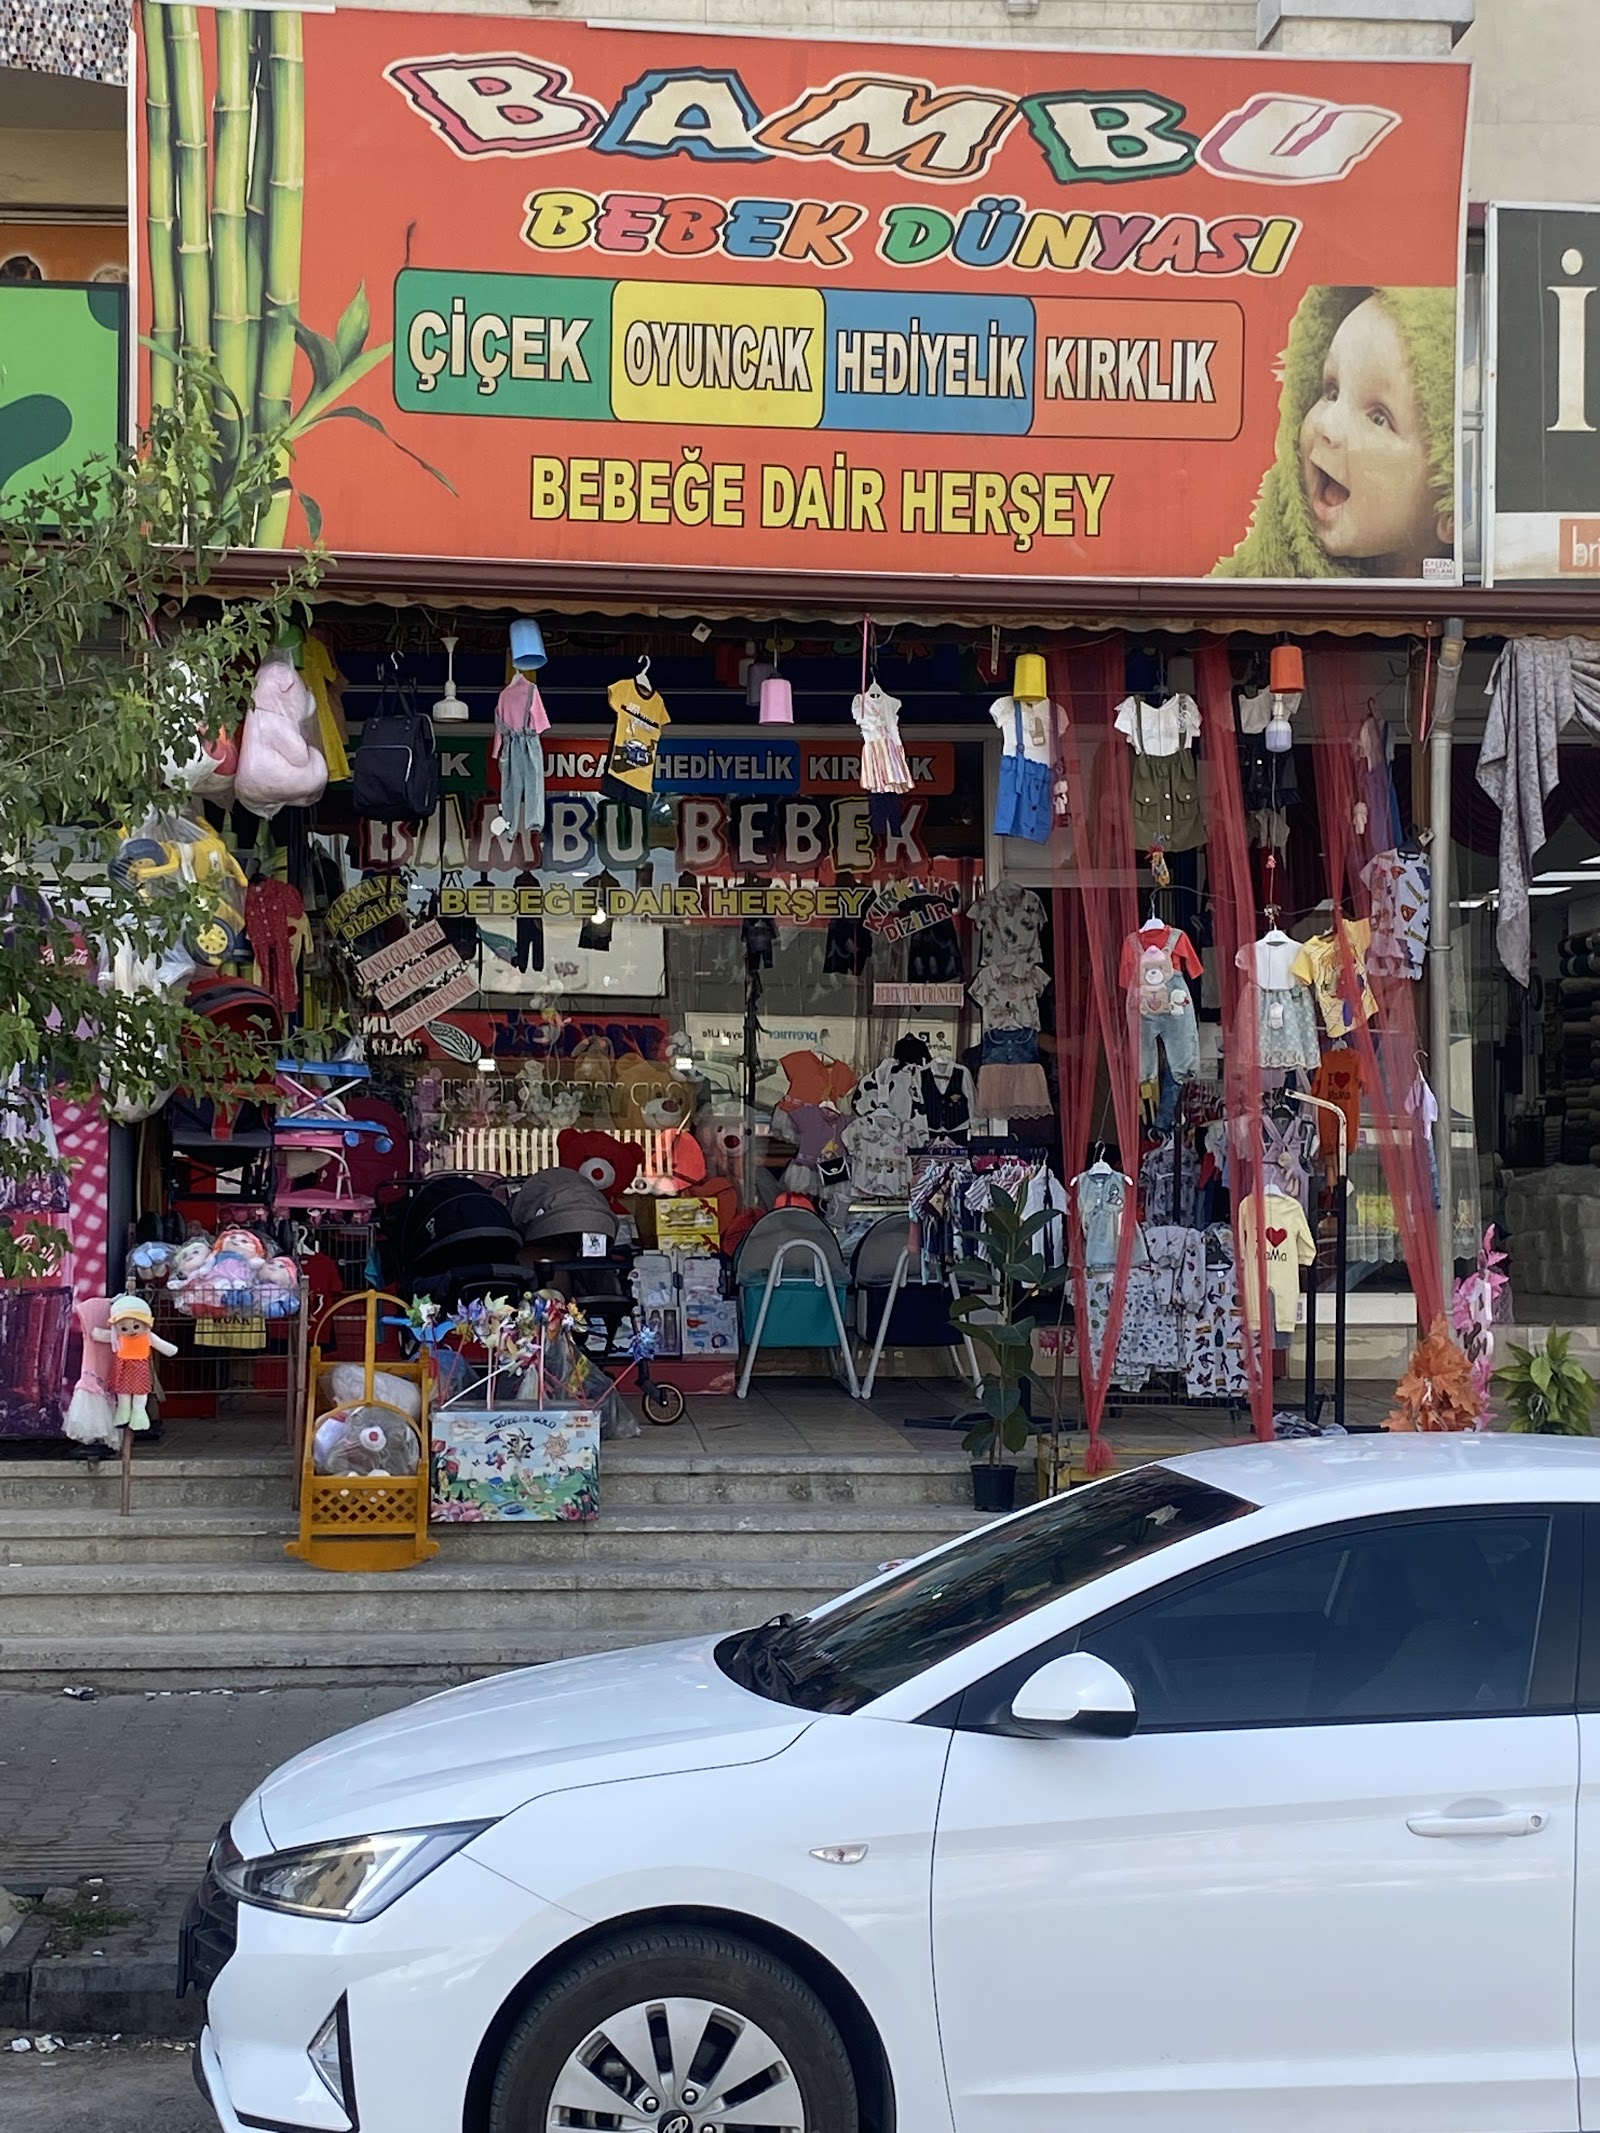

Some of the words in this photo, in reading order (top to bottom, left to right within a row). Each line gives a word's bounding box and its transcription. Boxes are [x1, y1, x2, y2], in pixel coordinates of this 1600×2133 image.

[384, 51, 1402, 186] BAMBU
[523, 187, 869, 268] BEBEK
[880, 195, 1303, 276] DÜNYASI
[408, 297, 592, 396] ÇİÇEK
[624, 320, 814, 393] OYUNCAK
[836, 317, 1027, 400] HEDİYELİK
[1044, 336, 1217, 403] KIRKLIK
[530, 446, 745, 527] BEBEĞE
[761, 450, 885, 534] DAİR
[901, 469, 1113, 553] HERŞEY
[655, 749, 794, 780] HEDİYELİK
[360, 795, 650, 873] BAMBU
[675, 796, 928, 873] BEBEK
[439, 882, 599, 918] BEBEĞE
[607, 882, 704, 918] DAİR
[711, 886, 869, 923] HERŞEY
[863, 875, 956, 935] KIRKLIK
